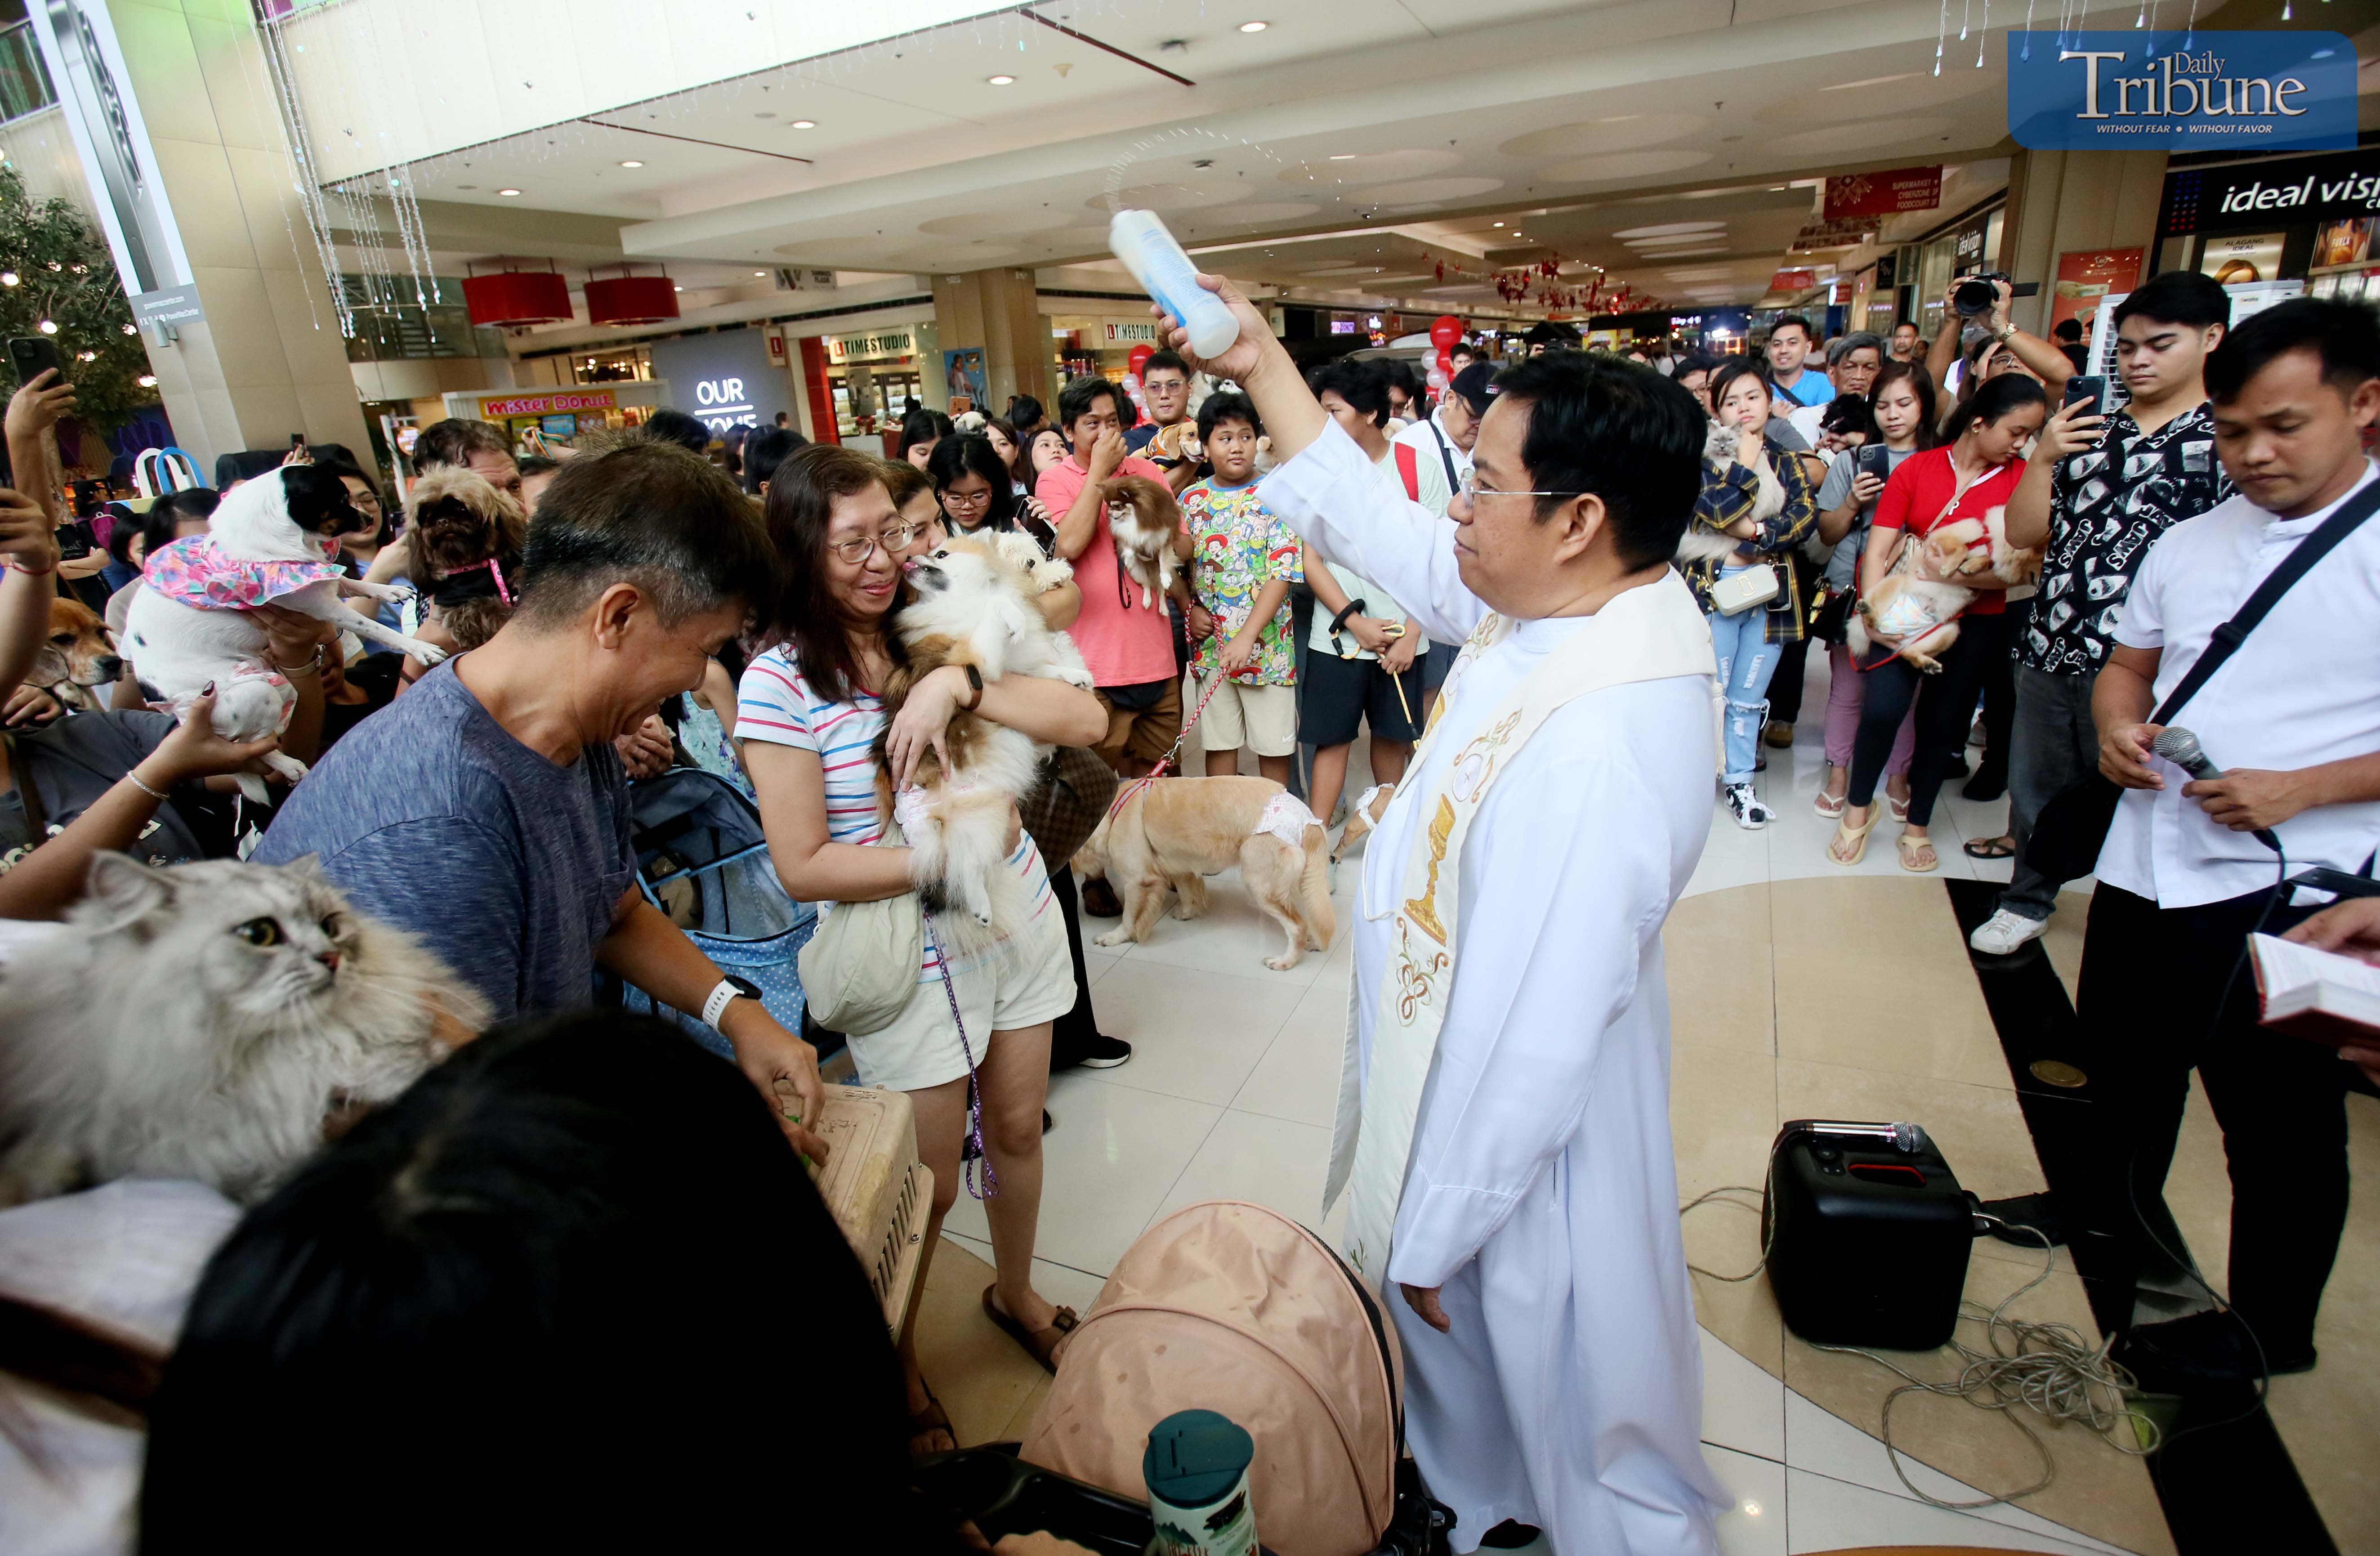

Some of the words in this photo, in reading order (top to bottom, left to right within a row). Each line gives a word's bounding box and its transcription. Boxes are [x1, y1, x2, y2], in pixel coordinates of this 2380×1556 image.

[1892, 179, 1931, 190] SUPERMARKET
[1898, 189, 1930, 200] CYBERZONE
[2220, 176, 2315, 213] ideal
[1897, 199, 1930, 209] FOODCOURT
[2225, 237, 2264, 246] ALAGANG
[1115, 324, 1155, 339] TIMESTUDIO
[844, 334, 910, 354] TIMESTUDIO
[697, 378, 745, 405] OUR
[704, 414, 757, 432] OME
[2058, 518, 2094, 569] JAWS
[2106, 521, 2149, 571] JAWS
